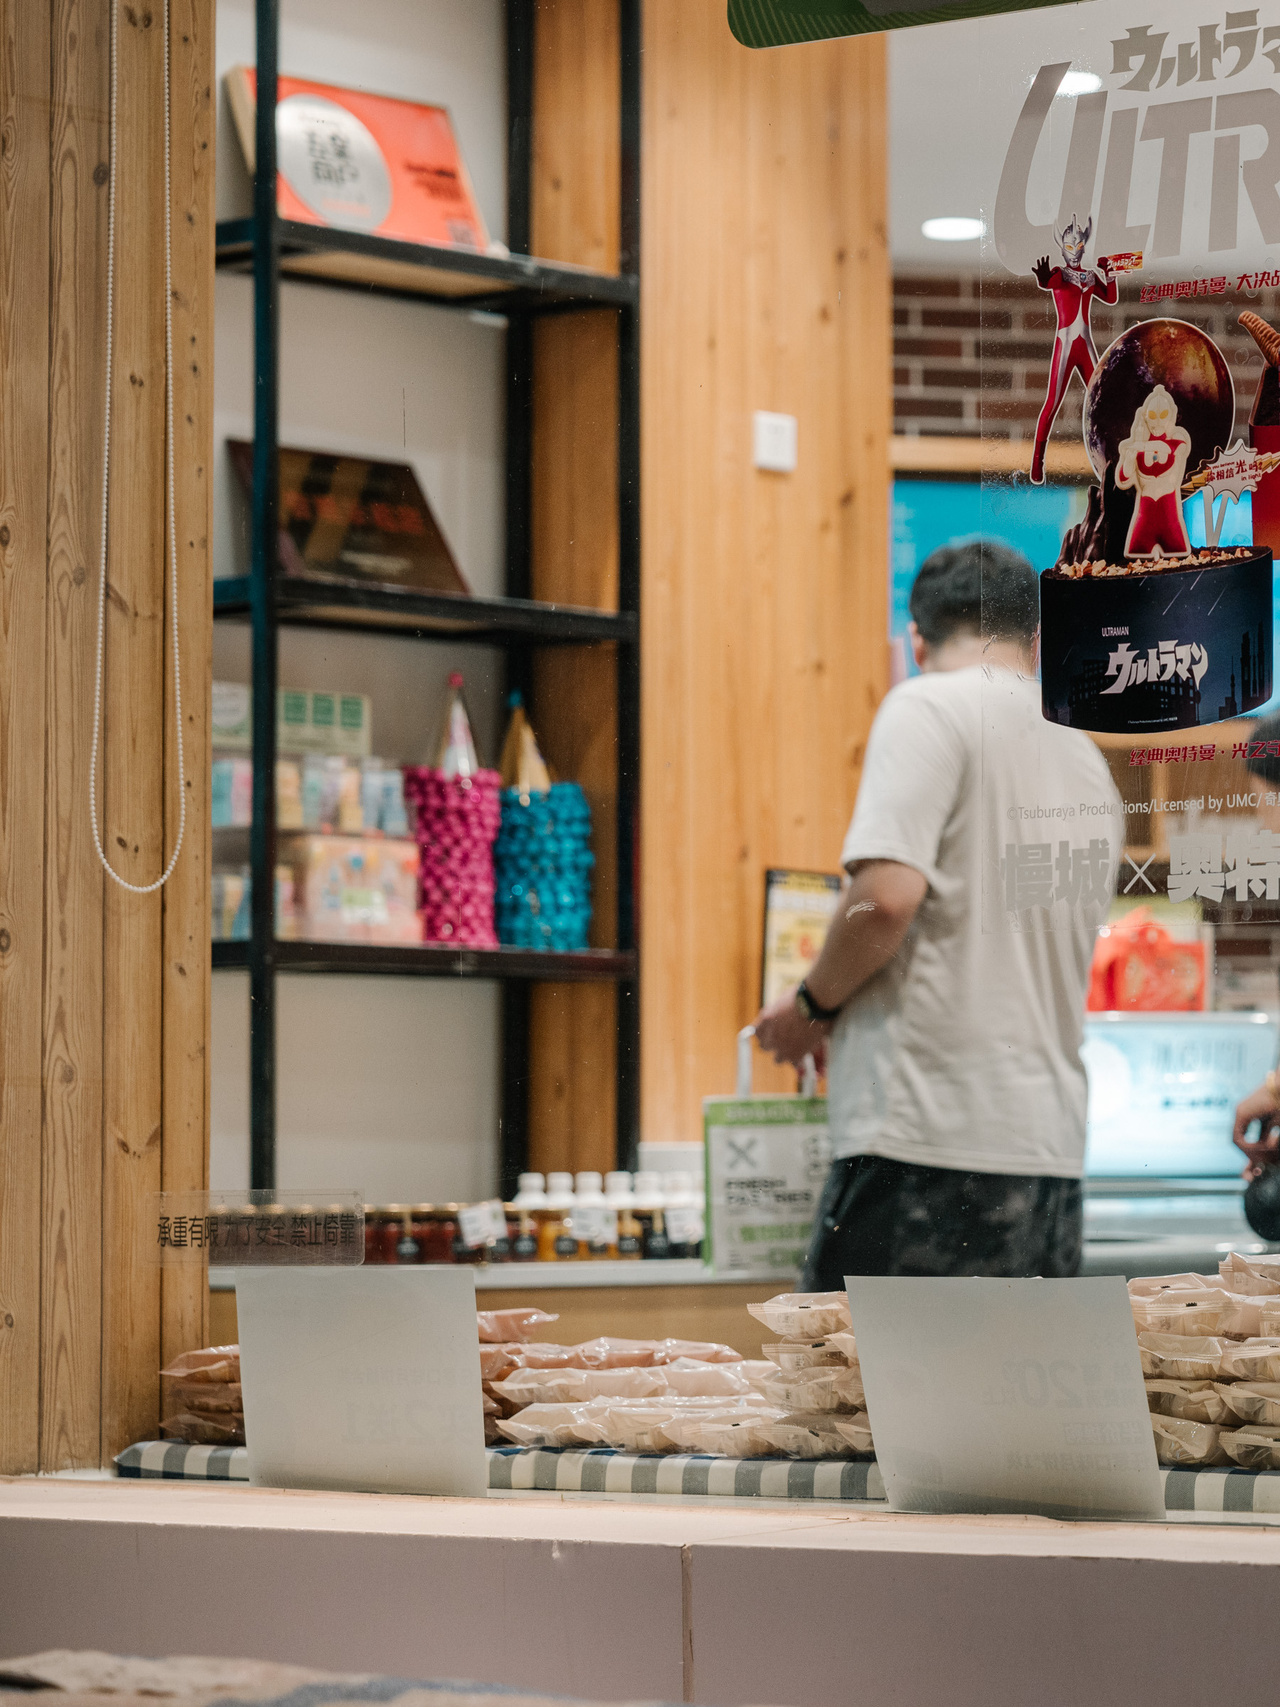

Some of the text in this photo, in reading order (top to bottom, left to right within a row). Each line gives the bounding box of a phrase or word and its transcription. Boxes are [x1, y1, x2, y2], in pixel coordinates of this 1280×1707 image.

[1102, 626, 1129, 637] ULTRAMAN
[1099, 640, 1208, 694] ウルトラマン
[1208, 795, 1223, 812] by
[157, 1215, 219, 1248] 承重有限
[291, 1213, 355, 1248] 禁止倚靠
